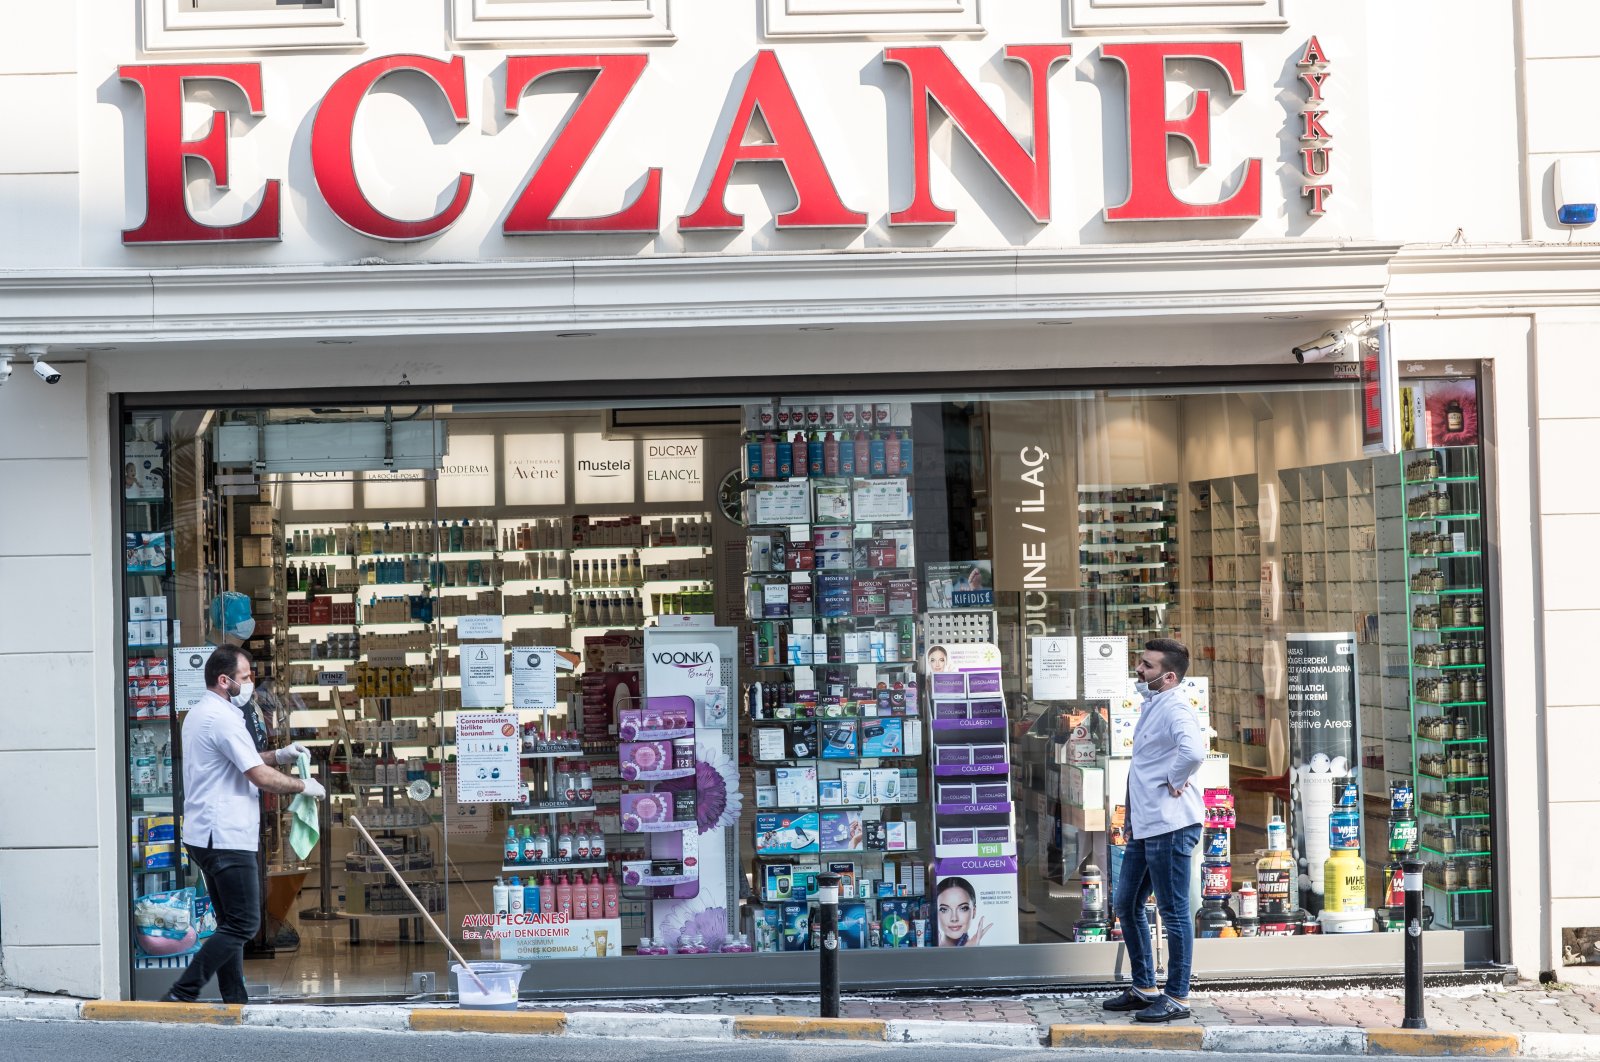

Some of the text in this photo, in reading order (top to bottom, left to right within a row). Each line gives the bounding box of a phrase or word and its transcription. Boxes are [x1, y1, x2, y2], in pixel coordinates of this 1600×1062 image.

[1298, 35, 1333, 214] AYKUT
[118, 42, 1264, 245] ECZANE
[650, 445, 698, 457] DUCRAY
[440, 465, 489, 474] BIODERMA
[512, 466, 559, 479] Avène
[648, 470, 700, 480] ELANCYL
[1016, 446, 1049, 512] İLAÇ
[652, 651, 714, 664] VOONKA
[1305, 692, 1328, 700] KREMİ
[1324, 719, 1352, 728] Areas
[962, 860, 1005, 869] COLLAGEN
[1258, 872, 1279, 882] WHEY
[1258, 882, 1288, 892] PROTEIN
[462, 909, 570, 927] AYKUT ECZANESİ
[462, 928, 570, 941] Ecz. Aykut DENKDEMİR
[517, 946, 540, 954] GÜNEŞ
